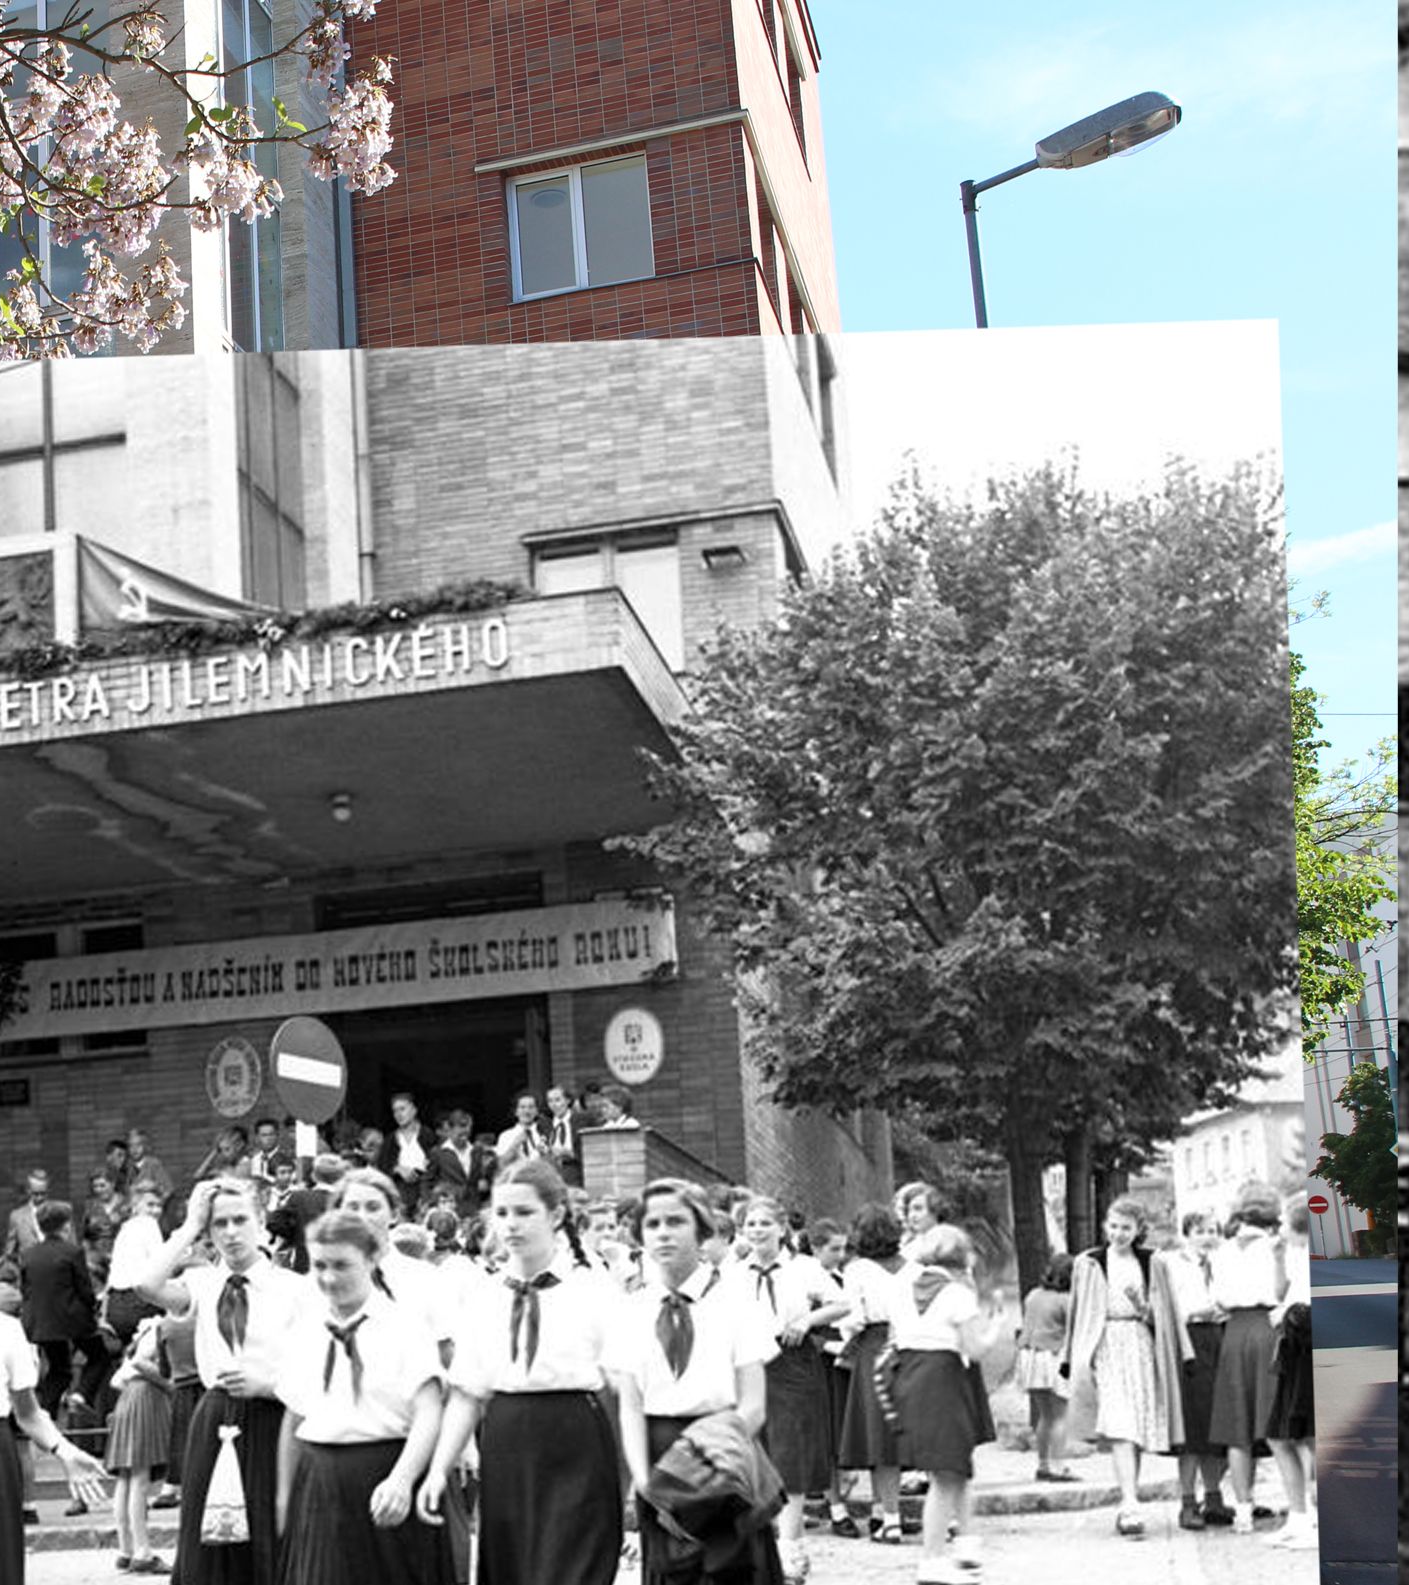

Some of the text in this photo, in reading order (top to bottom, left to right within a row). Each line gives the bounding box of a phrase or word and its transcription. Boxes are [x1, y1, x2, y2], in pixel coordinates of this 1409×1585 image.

[126, 617, 511, 714] JILEMNICKÉHO
[162, 972, 175, 1002] A
[295, 958, 321, 991] DO
[429, 928, 559, 980] ŠKOLSKÉHO
